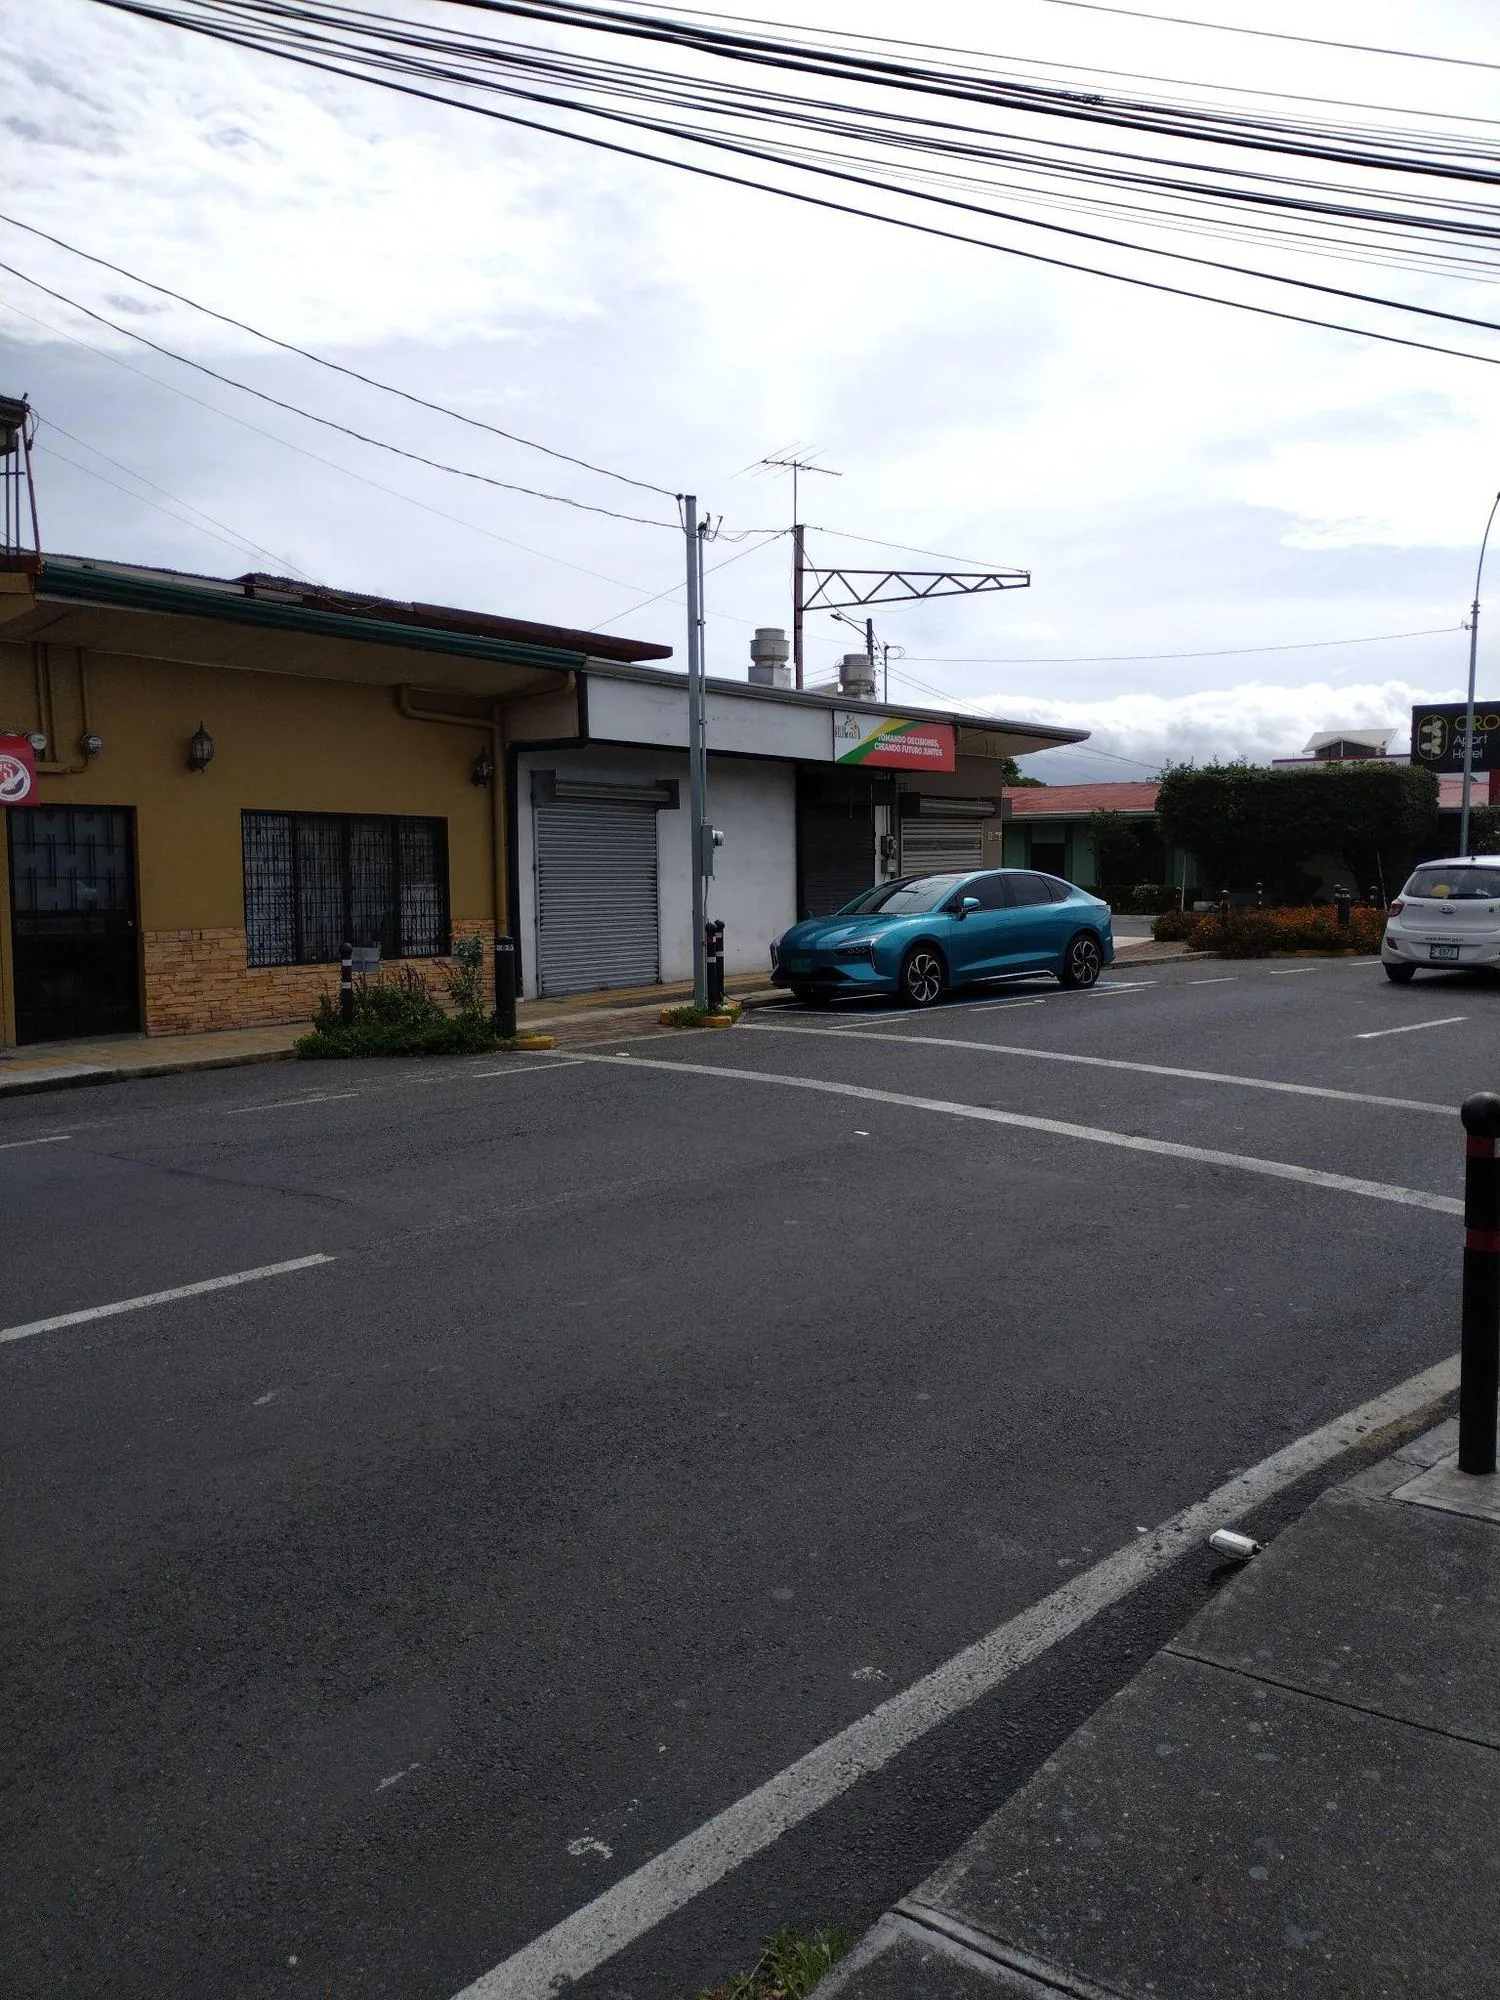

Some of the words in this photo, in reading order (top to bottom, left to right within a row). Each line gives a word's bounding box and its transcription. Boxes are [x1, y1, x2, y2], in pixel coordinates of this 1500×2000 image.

[879, 733, 906, 743] TOMANDO
[874, 743, 901, 752] CREANDO
[901, 745, 923, 755] FUTURO
[923, 748, 943, 757] JUNTOS
